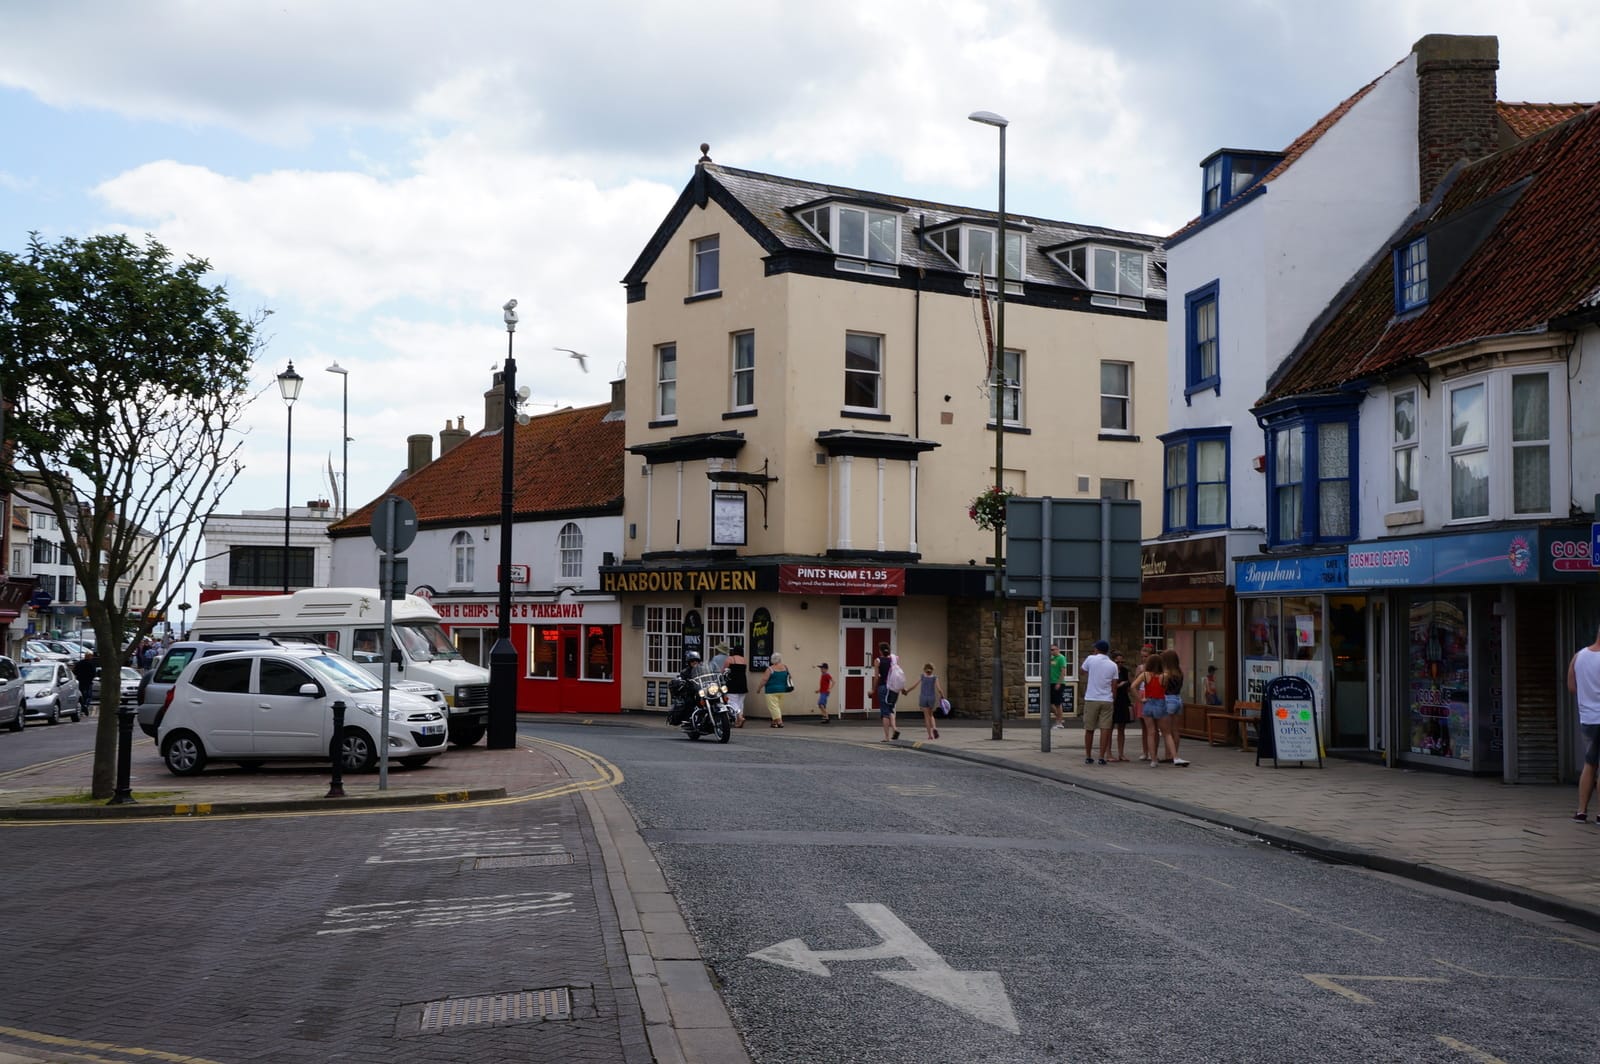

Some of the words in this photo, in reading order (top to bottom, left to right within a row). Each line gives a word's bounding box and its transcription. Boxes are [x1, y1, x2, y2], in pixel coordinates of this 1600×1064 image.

[1551, 541, 1592, 557] COS
[1349, 551, 1380, 568] COSMIC
[1382, 549, 1409, 567] GIFTS
[604, 571, 687, 592] HARBOUR
[689, 570, 757, 591] TAVERN
[797, 567, 826, 579] PINTS
[828, 569, 857, 580] FROM
[859, 570, 887, 581] £1.95
[1245, 560, 1301, 589] Baynham's
[454, 604, 460, 618] &
[463, 604, 489, 618] CHIPS
[521, 604, 527, 618] &
[531, 603, 584, 618] TAKEAWAY
[1280, 727, 1307, 735] OPEN
